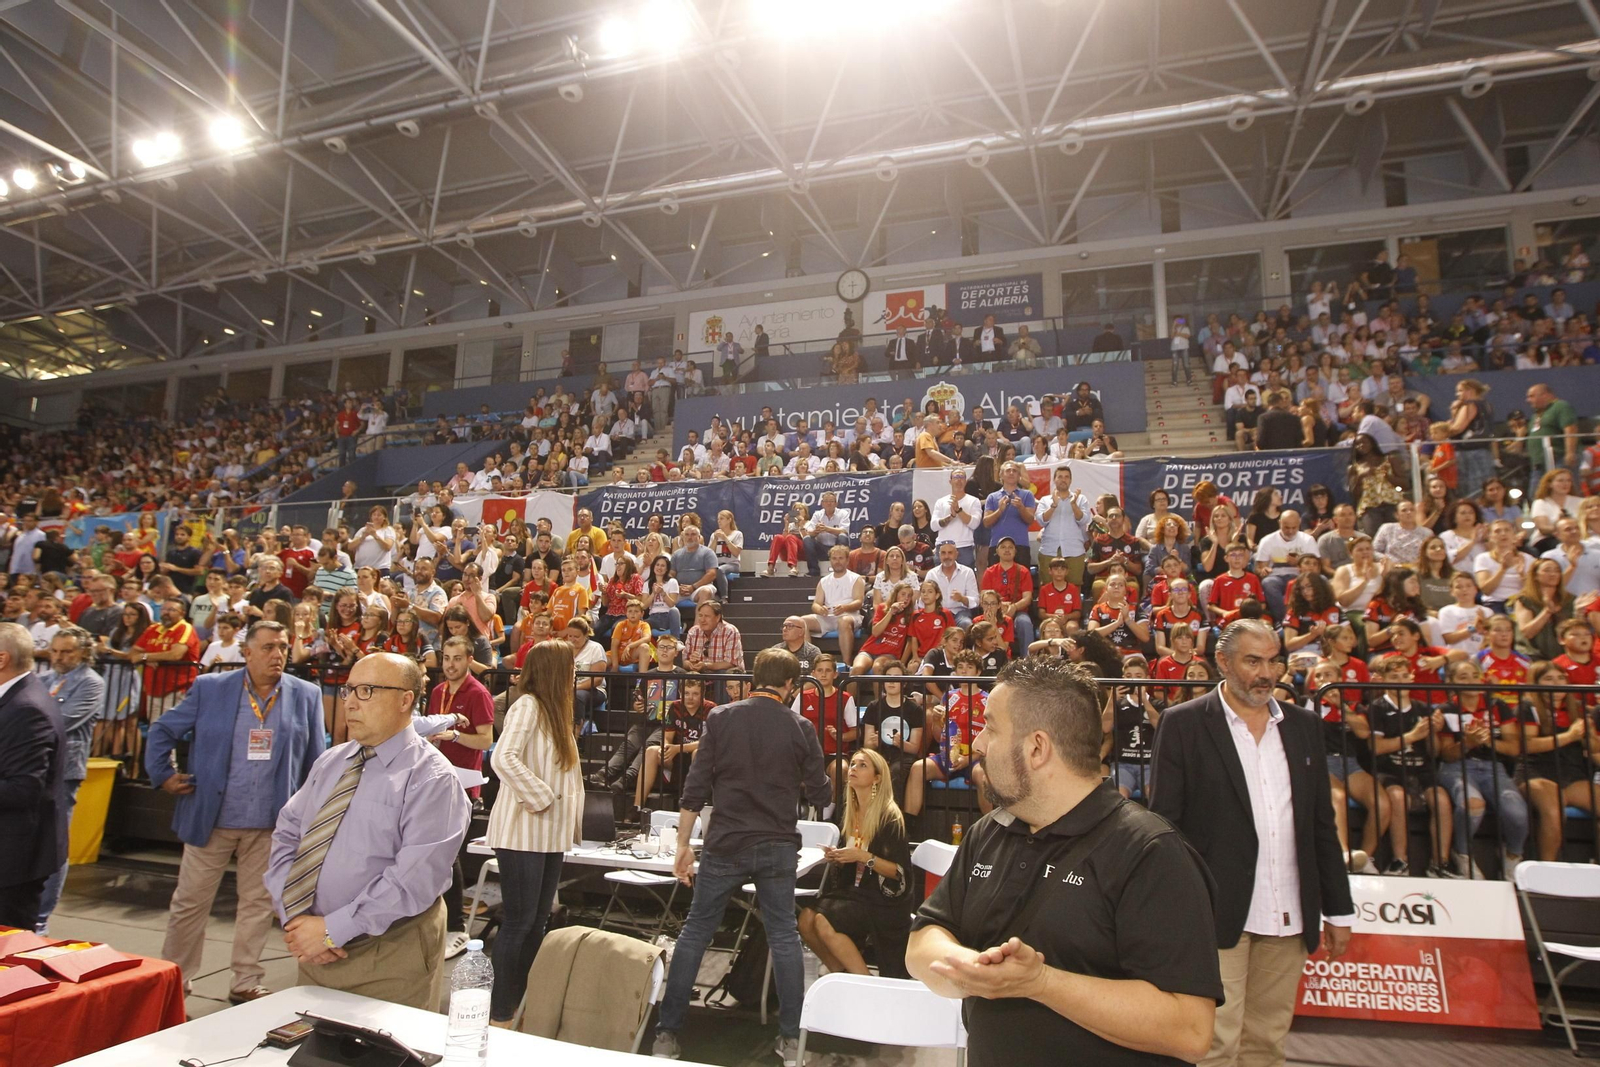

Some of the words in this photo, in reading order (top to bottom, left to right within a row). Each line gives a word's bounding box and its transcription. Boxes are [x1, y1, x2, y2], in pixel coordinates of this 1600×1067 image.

[961, 285, 1029, 299] DEPORTES
[961, 300, 977, 309] DE
[979, 295, 1029, 307] ALMERIA
[1165, 463, 1226, 471] PATRONATO
[1229, 459, 1286, 469] MUNICIPAL
[813, 480, 856, 489] MUNICIPAL
[1163, 468, 1304, 490] DEPORTES
[649, 488, 685, 497] MUNICIPAL
[601, 497, 698, 514] DEPORTES
[625, 514, 681, 529] ALER
[759, 510, 784, 523] DE
[688, 729, 698, 739] 22
[1419, 949, 1435, 965] la
[1302, 959, 1438, 982] COOPERATIVA
[1320, 977, 1439, 996] AGRICULTORES
[1302, 990, 1441, 1013] ALMERIENSES
